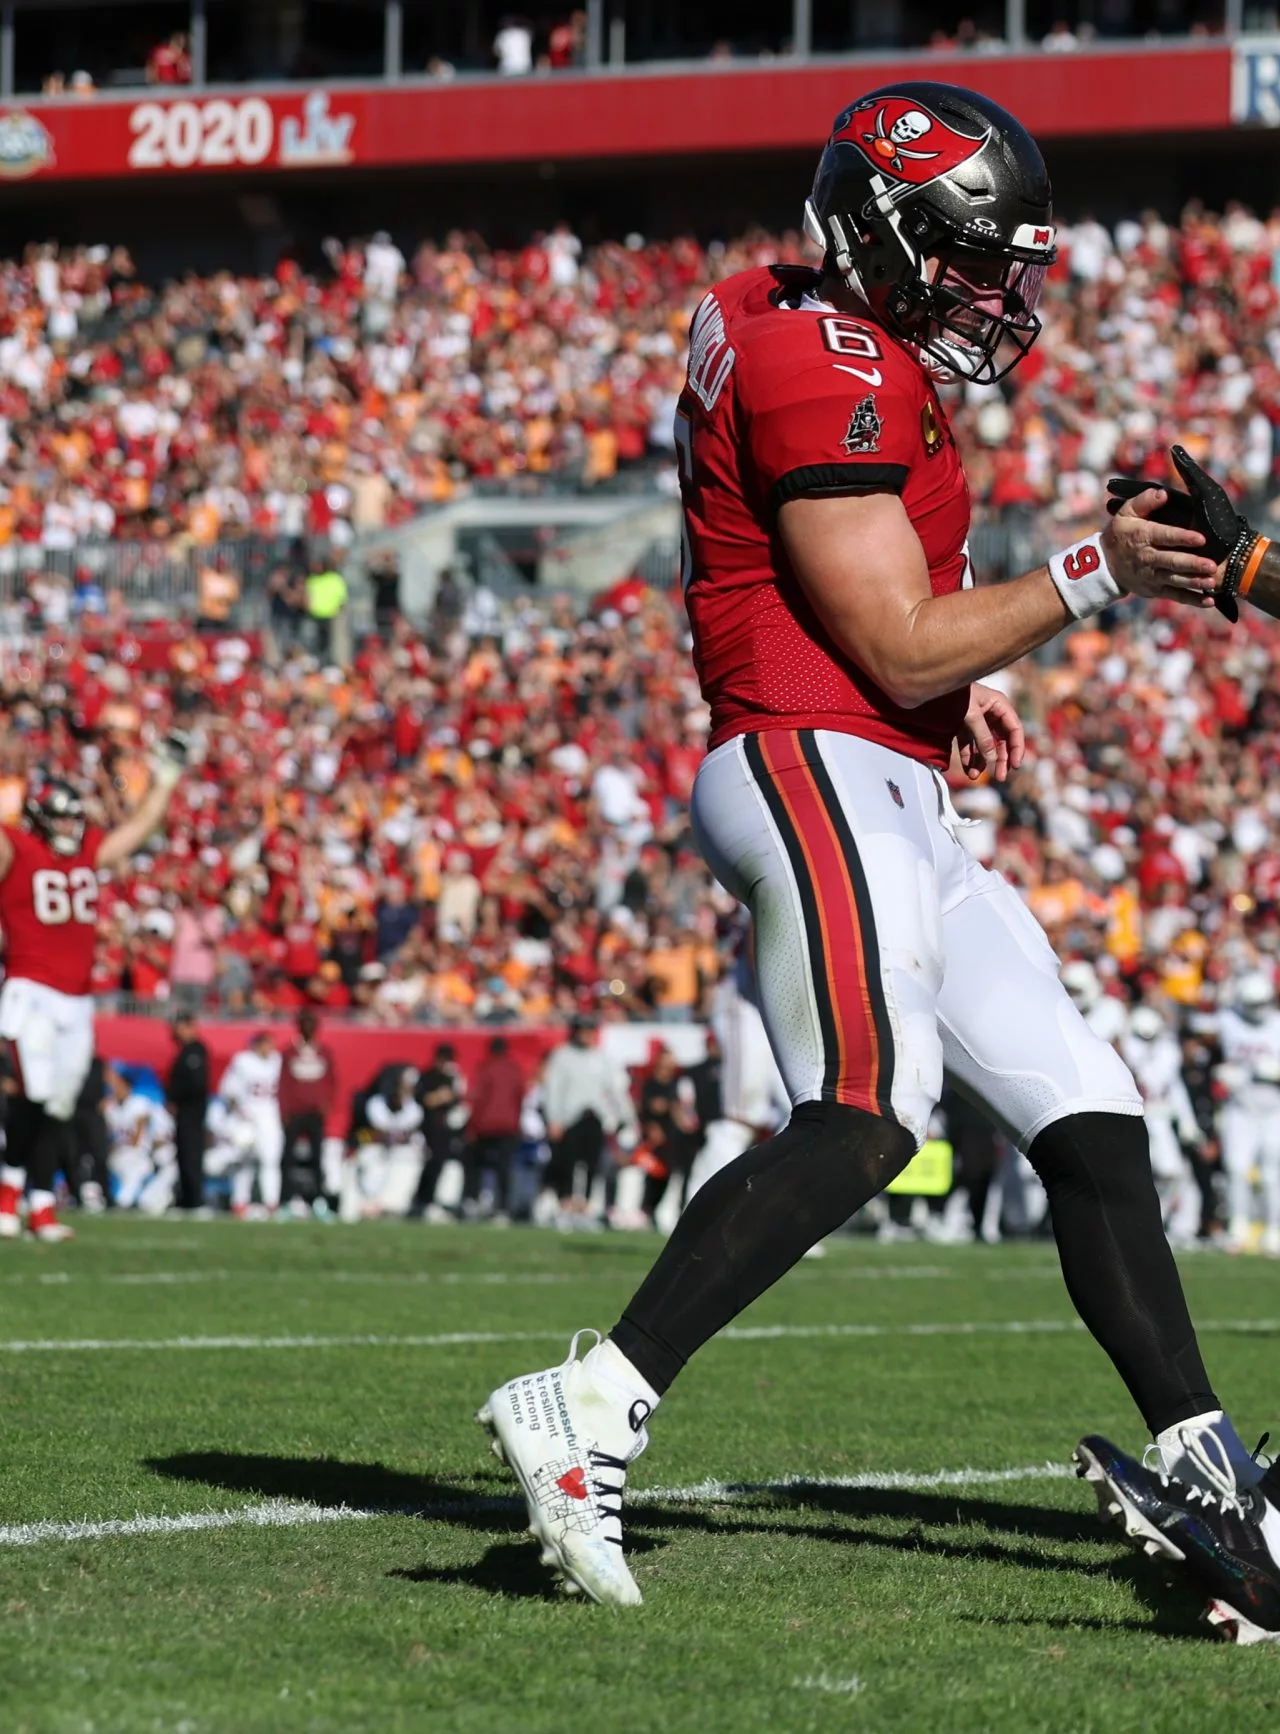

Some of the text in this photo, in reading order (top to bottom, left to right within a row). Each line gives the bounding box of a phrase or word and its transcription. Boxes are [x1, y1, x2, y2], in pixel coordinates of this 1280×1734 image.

[129, 97, 274, 168] 2020
[965, 221, 1001, 239] OAKLEY
[818, 316, 883, 360] 6
[32, 867, 98, 926] 62
[509, 1393, 524, 1425] more
[524, 1389, 541, 1431] strong
[538, 1385, 561, 1439] resilient
[553, 1381, 580, 1452] successful
